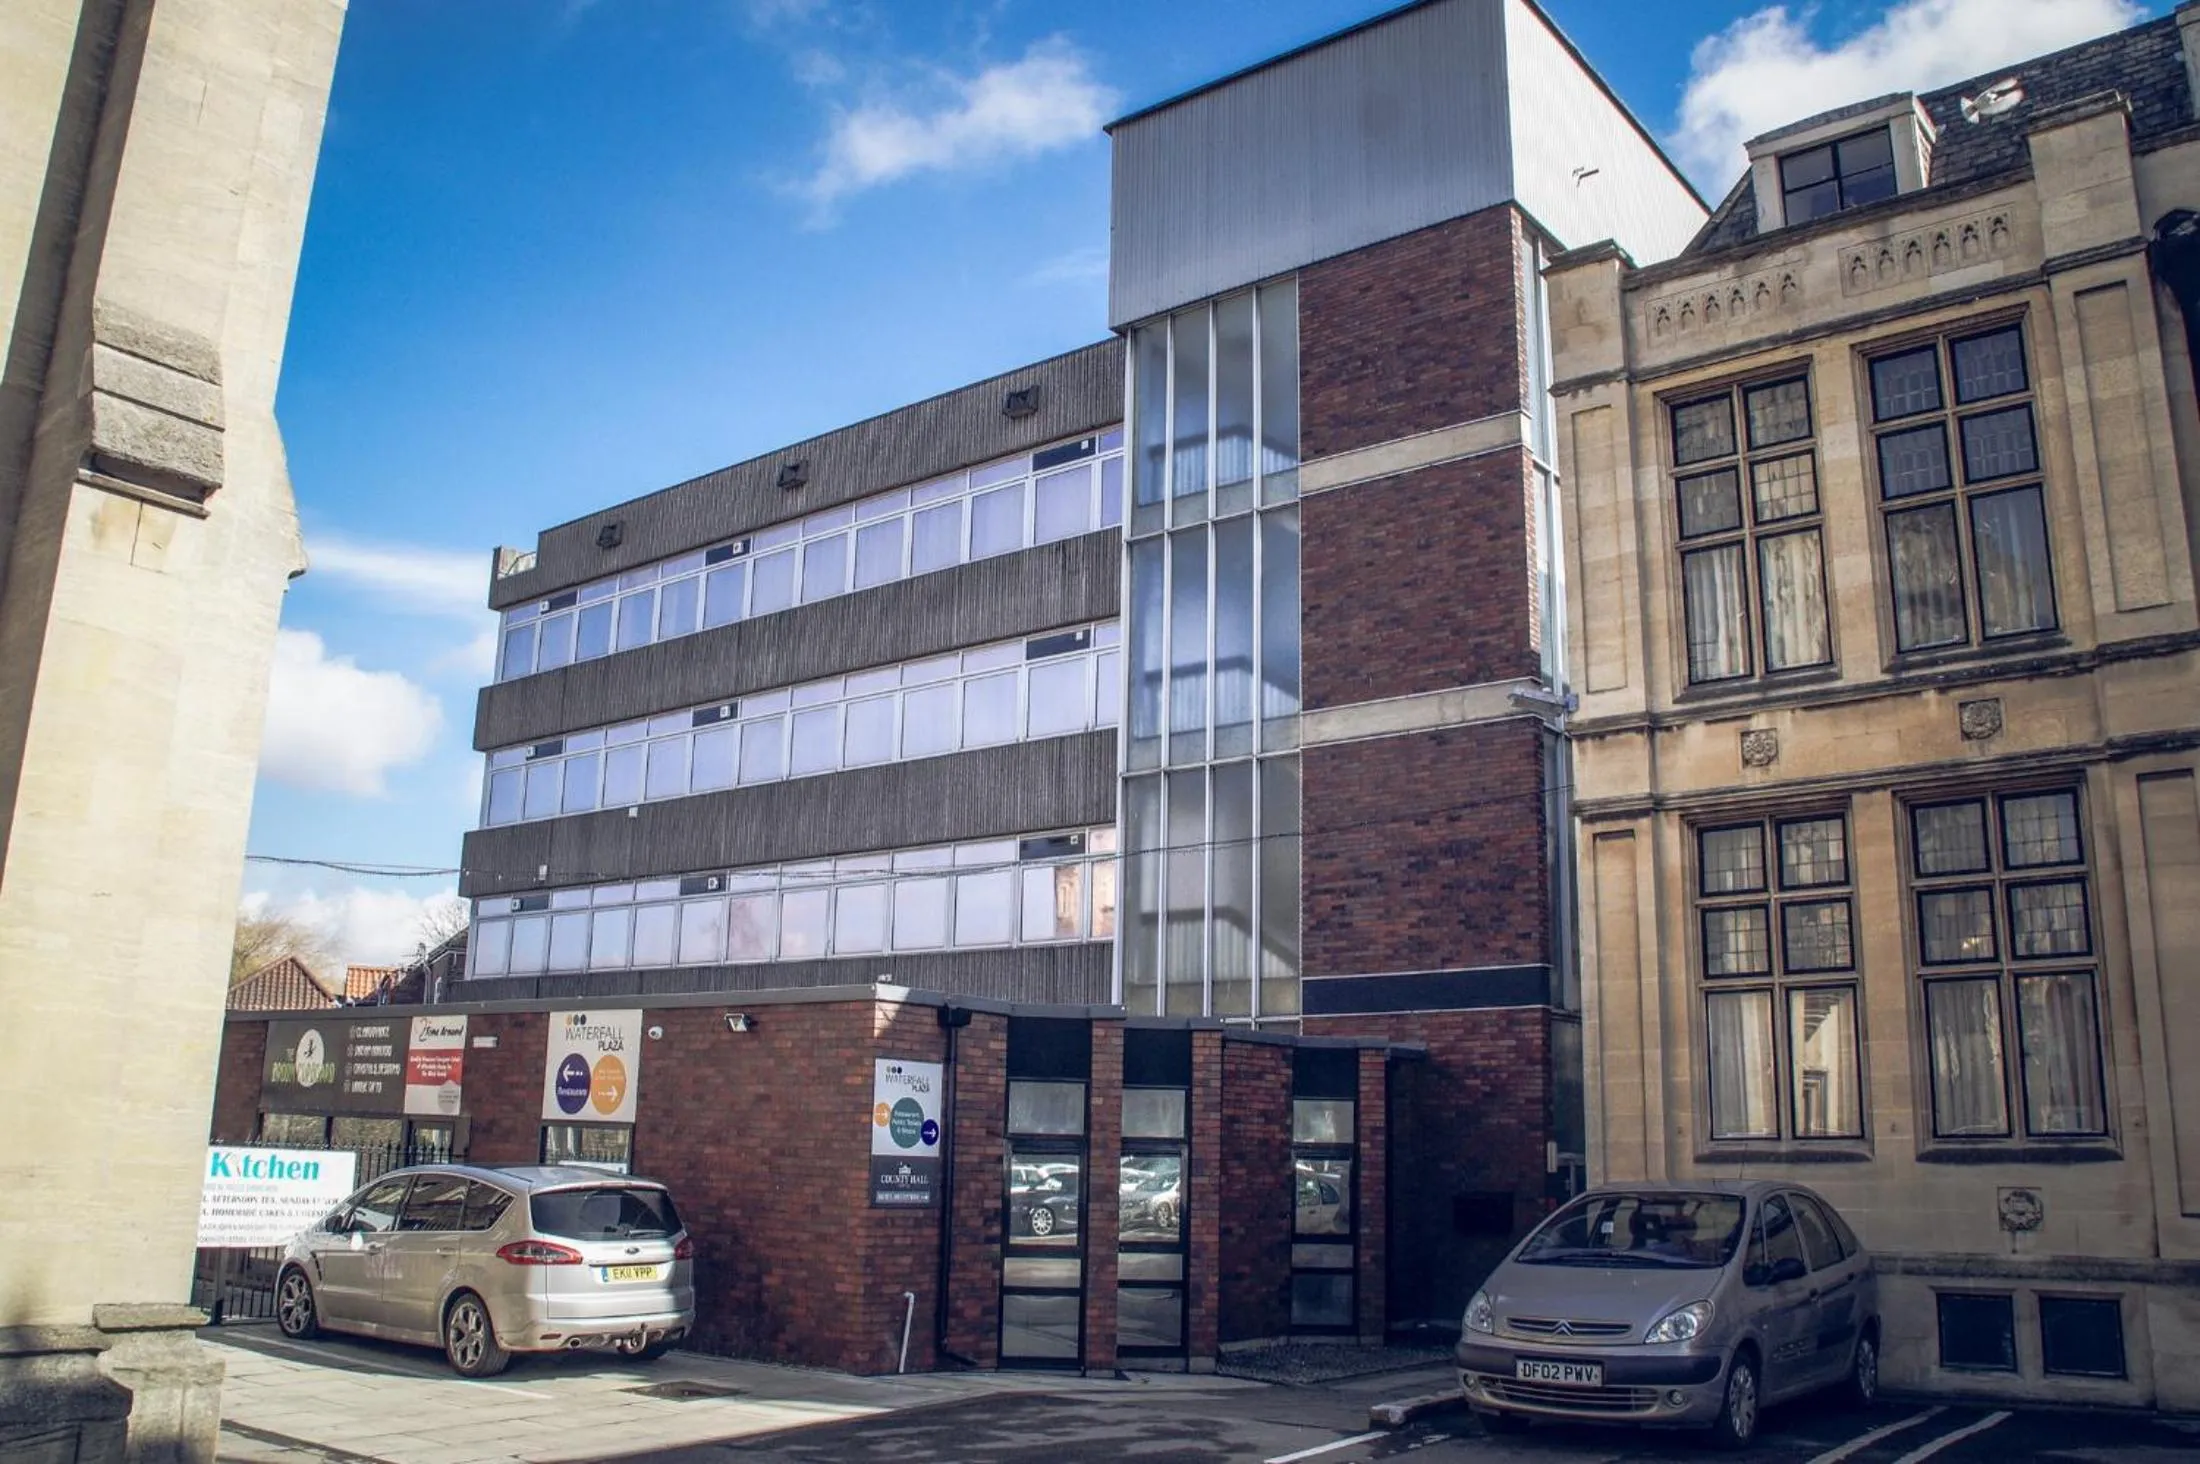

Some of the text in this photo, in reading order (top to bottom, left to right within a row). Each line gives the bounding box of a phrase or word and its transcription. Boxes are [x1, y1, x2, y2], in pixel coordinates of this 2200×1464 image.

[565, 1026, 625, 1041] WATERFALL
[598, 1040, 624, 1051] PLAZA
[885, 1074, 930, 1085] WATERFALL
[912, 1083, 930, 1093] PLAZA
[211, 1151, 320, 1181] Kitchen
[881, 1174, 928, 1184] COUNTY HALL
[1523, 1362, 1594, 1381] DF02 PWV
